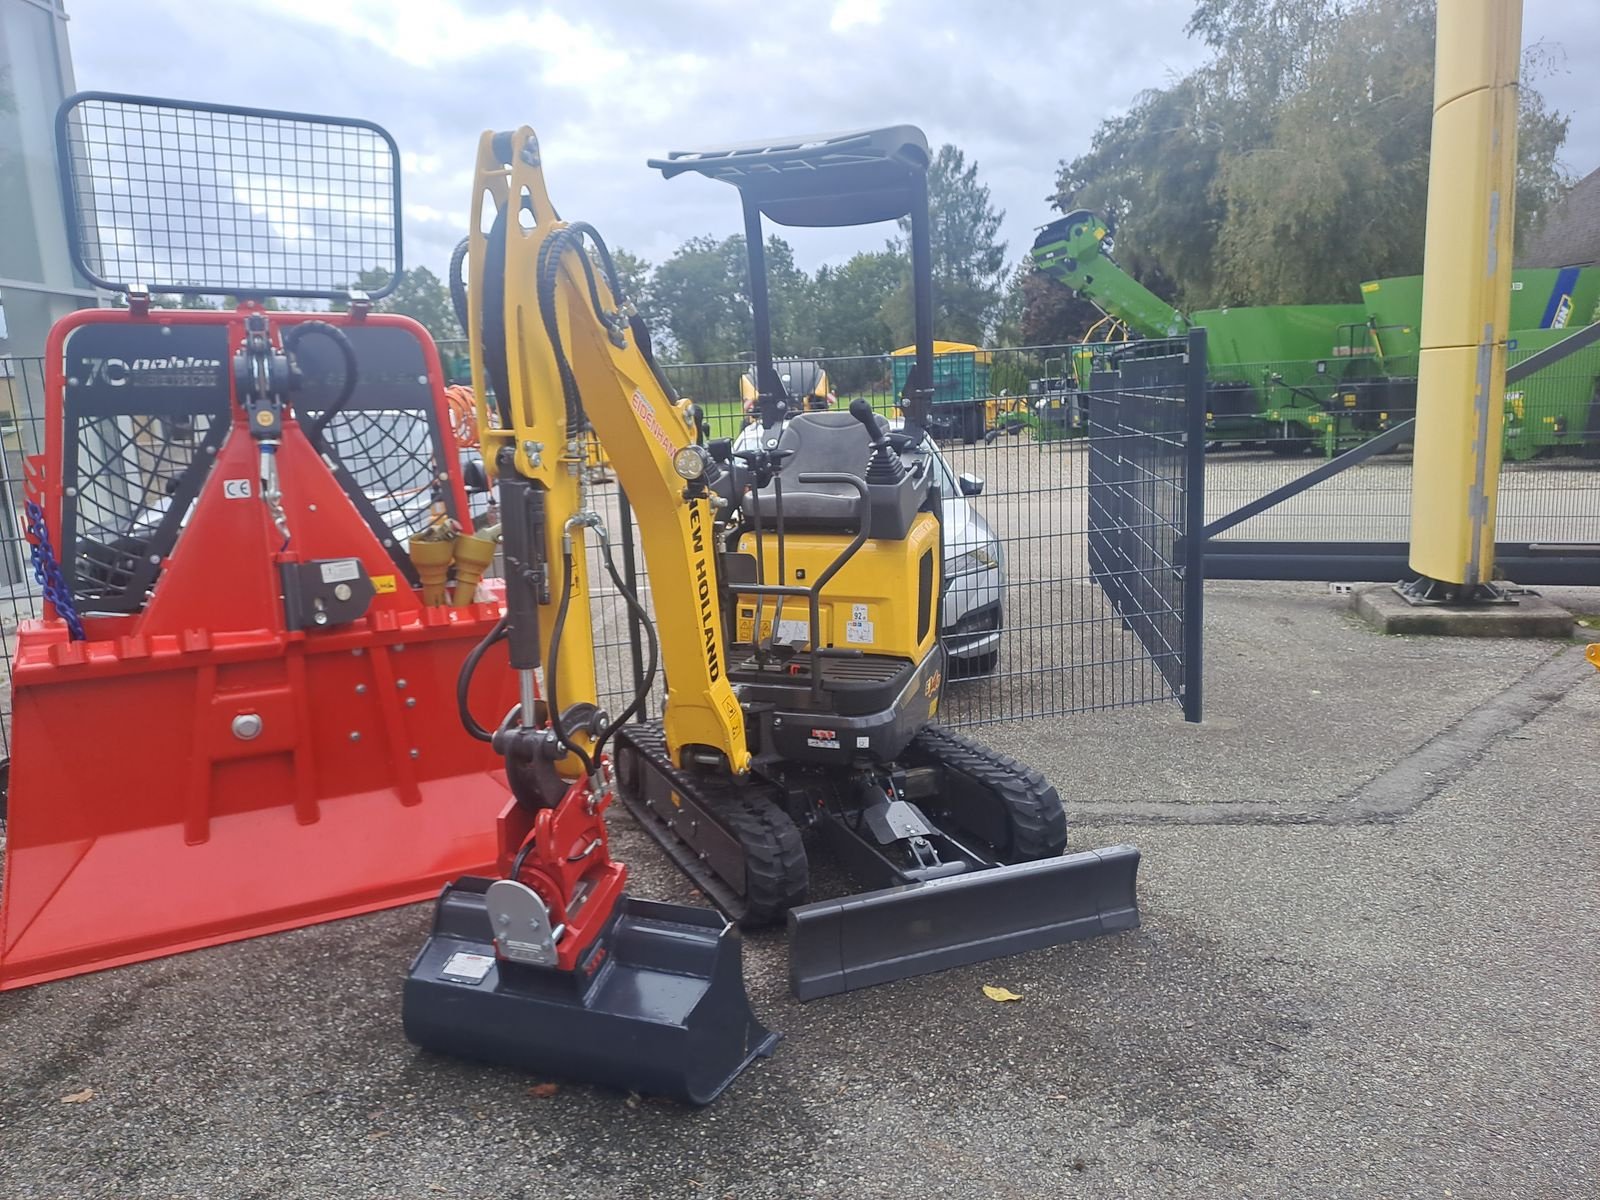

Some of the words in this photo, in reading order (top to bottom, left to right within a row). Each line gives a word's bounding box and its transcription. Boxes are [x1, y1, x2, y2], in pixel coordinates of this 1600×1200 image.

[82, 358, 130, 387] 70
[226, 481, 249, 496] CE
[696, 558, 720, 683] HOLLAND
